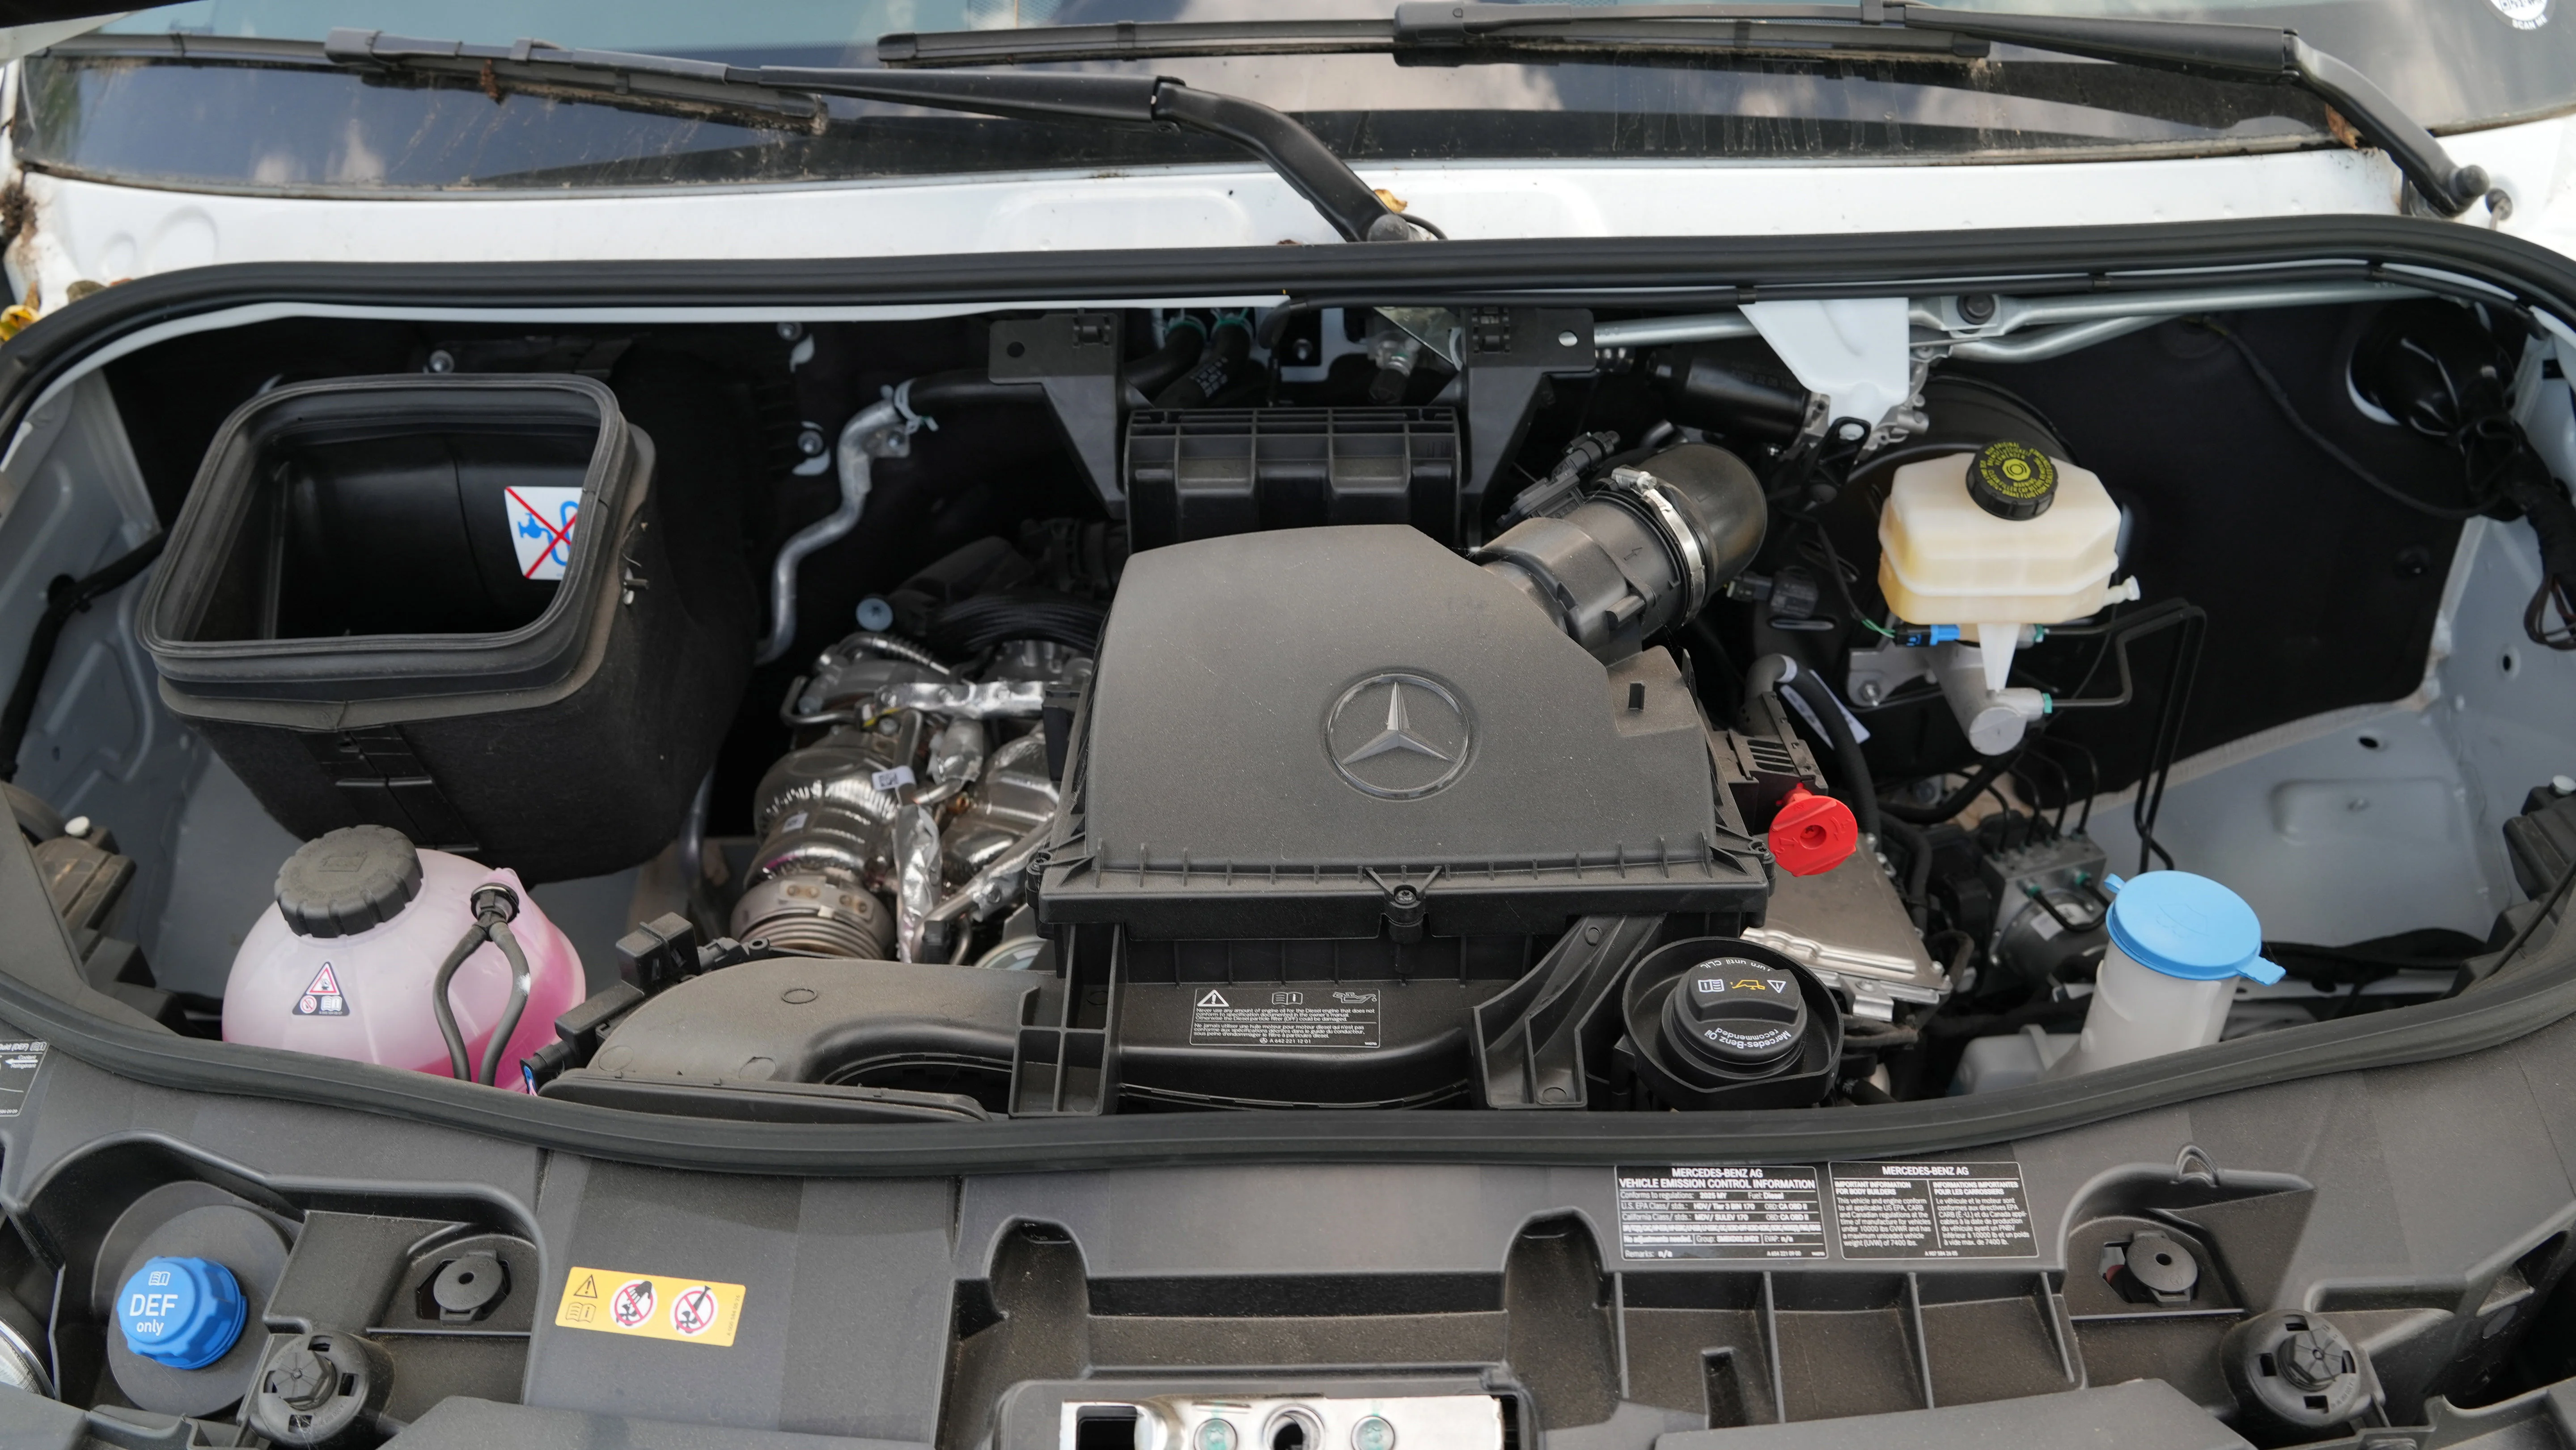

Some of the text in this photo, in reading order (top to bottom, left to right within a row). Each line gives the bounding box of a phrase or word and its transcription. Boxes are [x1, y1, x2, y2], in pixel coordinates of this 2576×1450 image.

[2512, 14, 2548, 30] SCAN ME
[1751, 962, 1771, 971] urn
[1704, 1030, 1792, 1049] Mercedes-Benz Oil
[1715, 1027, 1779, 1041] recommended
[11, 1043, 29, 1051] (DEF)
[1672, 1168, 1763, 1178] MERCEDES-BENZ AG
[1882, 1166, 1969, 1175] MERCEDES-BENZ AG
[1618, 1178, 1815, 1188] VEHICLE EMISSION CONTROL INFORMATION
[129, 1293, 178, 1316] DEF
[136, 1319, 165, 1336] only
